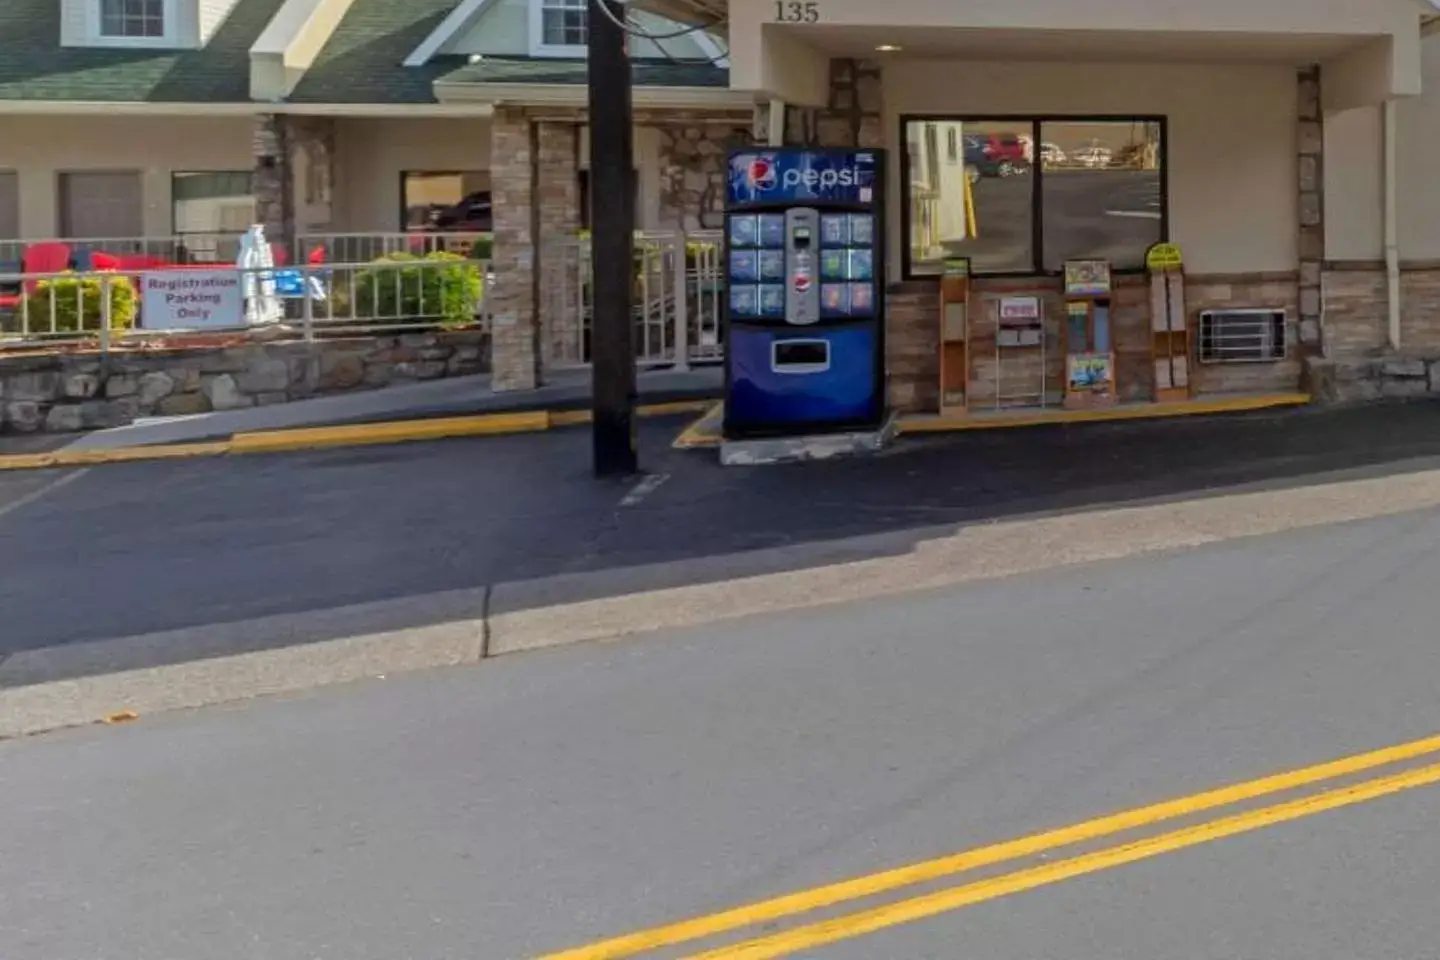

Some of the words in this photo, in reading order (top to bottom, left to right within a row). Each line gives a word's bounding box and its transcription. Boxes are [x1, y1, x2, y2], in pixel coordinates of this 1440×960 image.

[775, 0, 820, 23] 135
[782, 165, 860, 191] pepsi
[148, 278, 238, 290] Registration
[166, 293, 221, 305] Parking
[178, 307, 211, 320] Only
